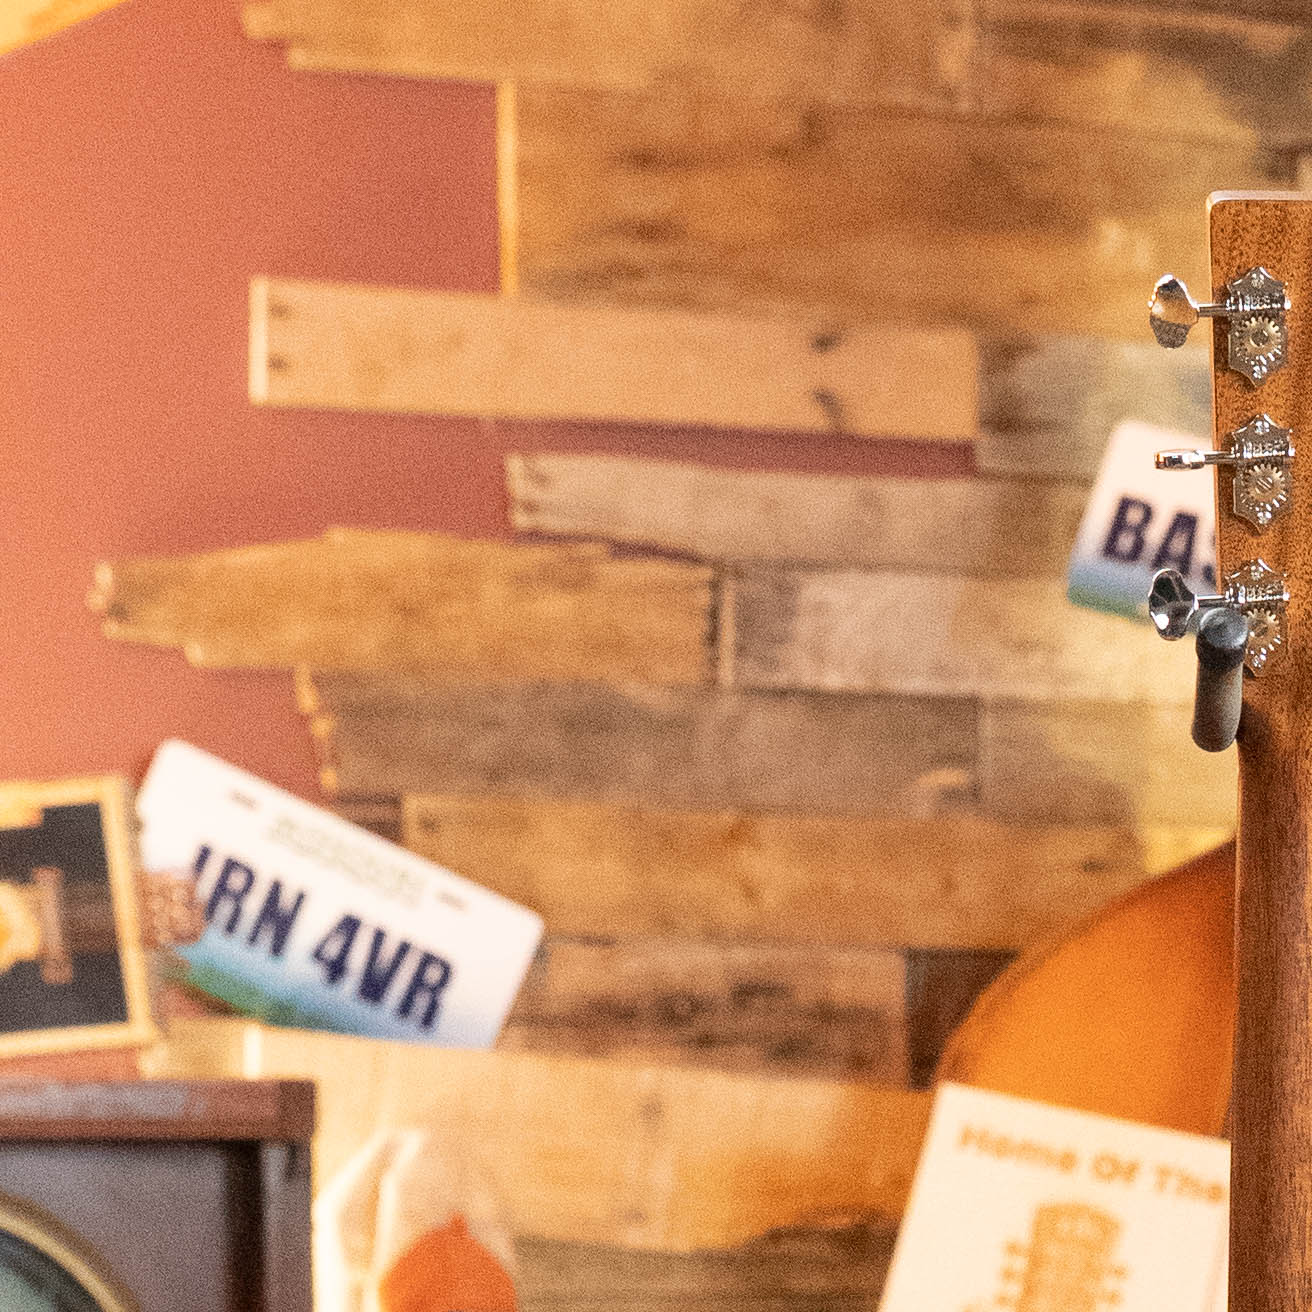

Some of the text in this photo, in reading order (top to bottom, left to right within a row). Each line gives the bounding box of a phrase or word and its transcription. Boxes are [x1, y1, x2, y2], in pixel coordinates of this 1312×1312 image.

[1102, 495, 1216, 588] BA
[311, 913, 454, 1028] 4VR
[960, 1124, 1076, 1174] Home
[1152, 1163, 1225, 1205] The
